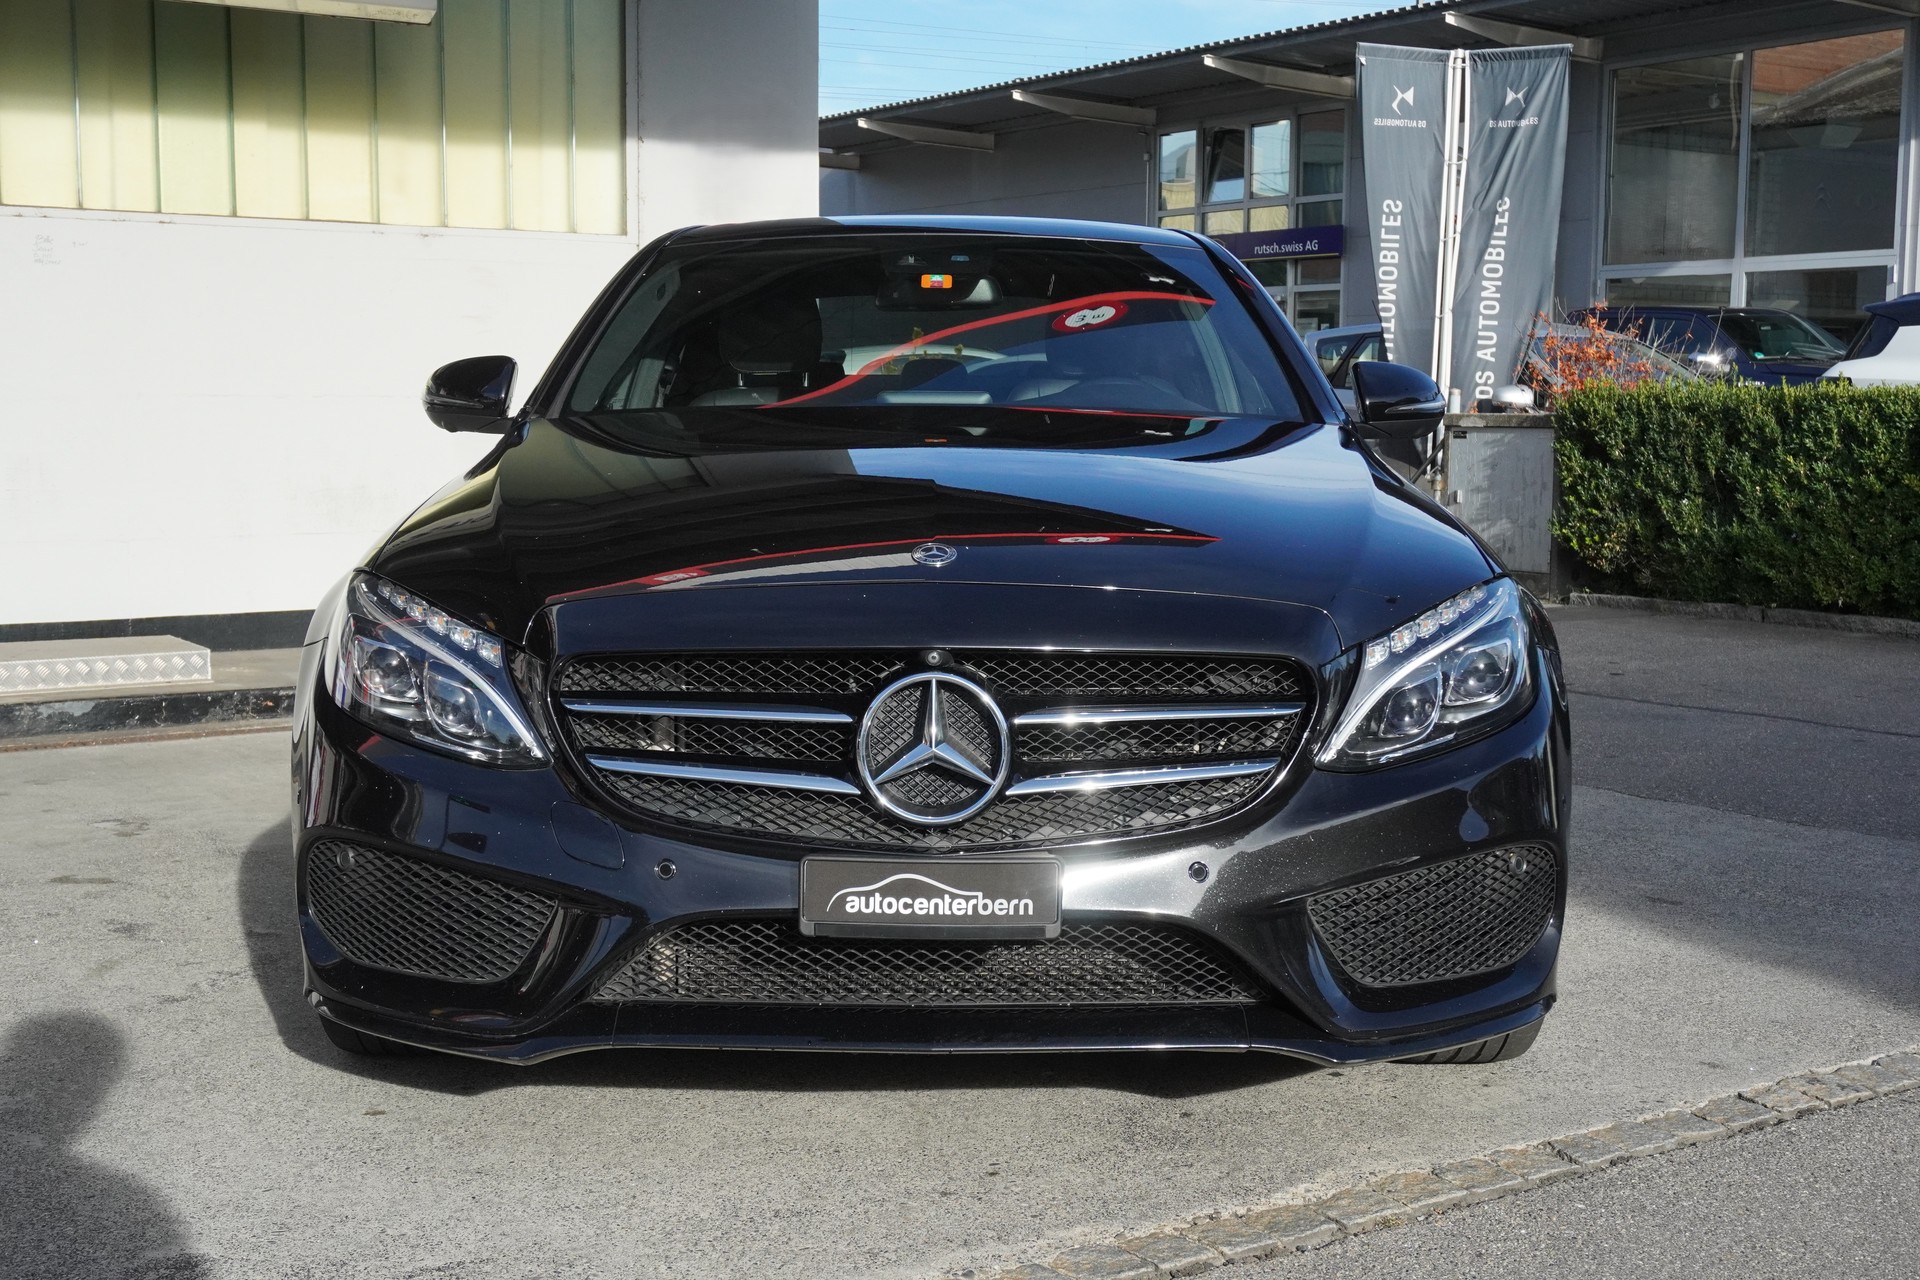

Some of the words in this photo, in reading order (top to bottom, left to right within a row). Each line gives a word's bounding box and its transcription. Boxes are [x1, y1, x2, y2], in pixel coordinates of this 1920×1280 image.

[1254, 241, 1304, 254] rutsch.swiss
[1305, 239, 1319, 251] AG
[1475, 371, 1495, 399] DS
[845, 892, 1034, 916] autocenterbern
